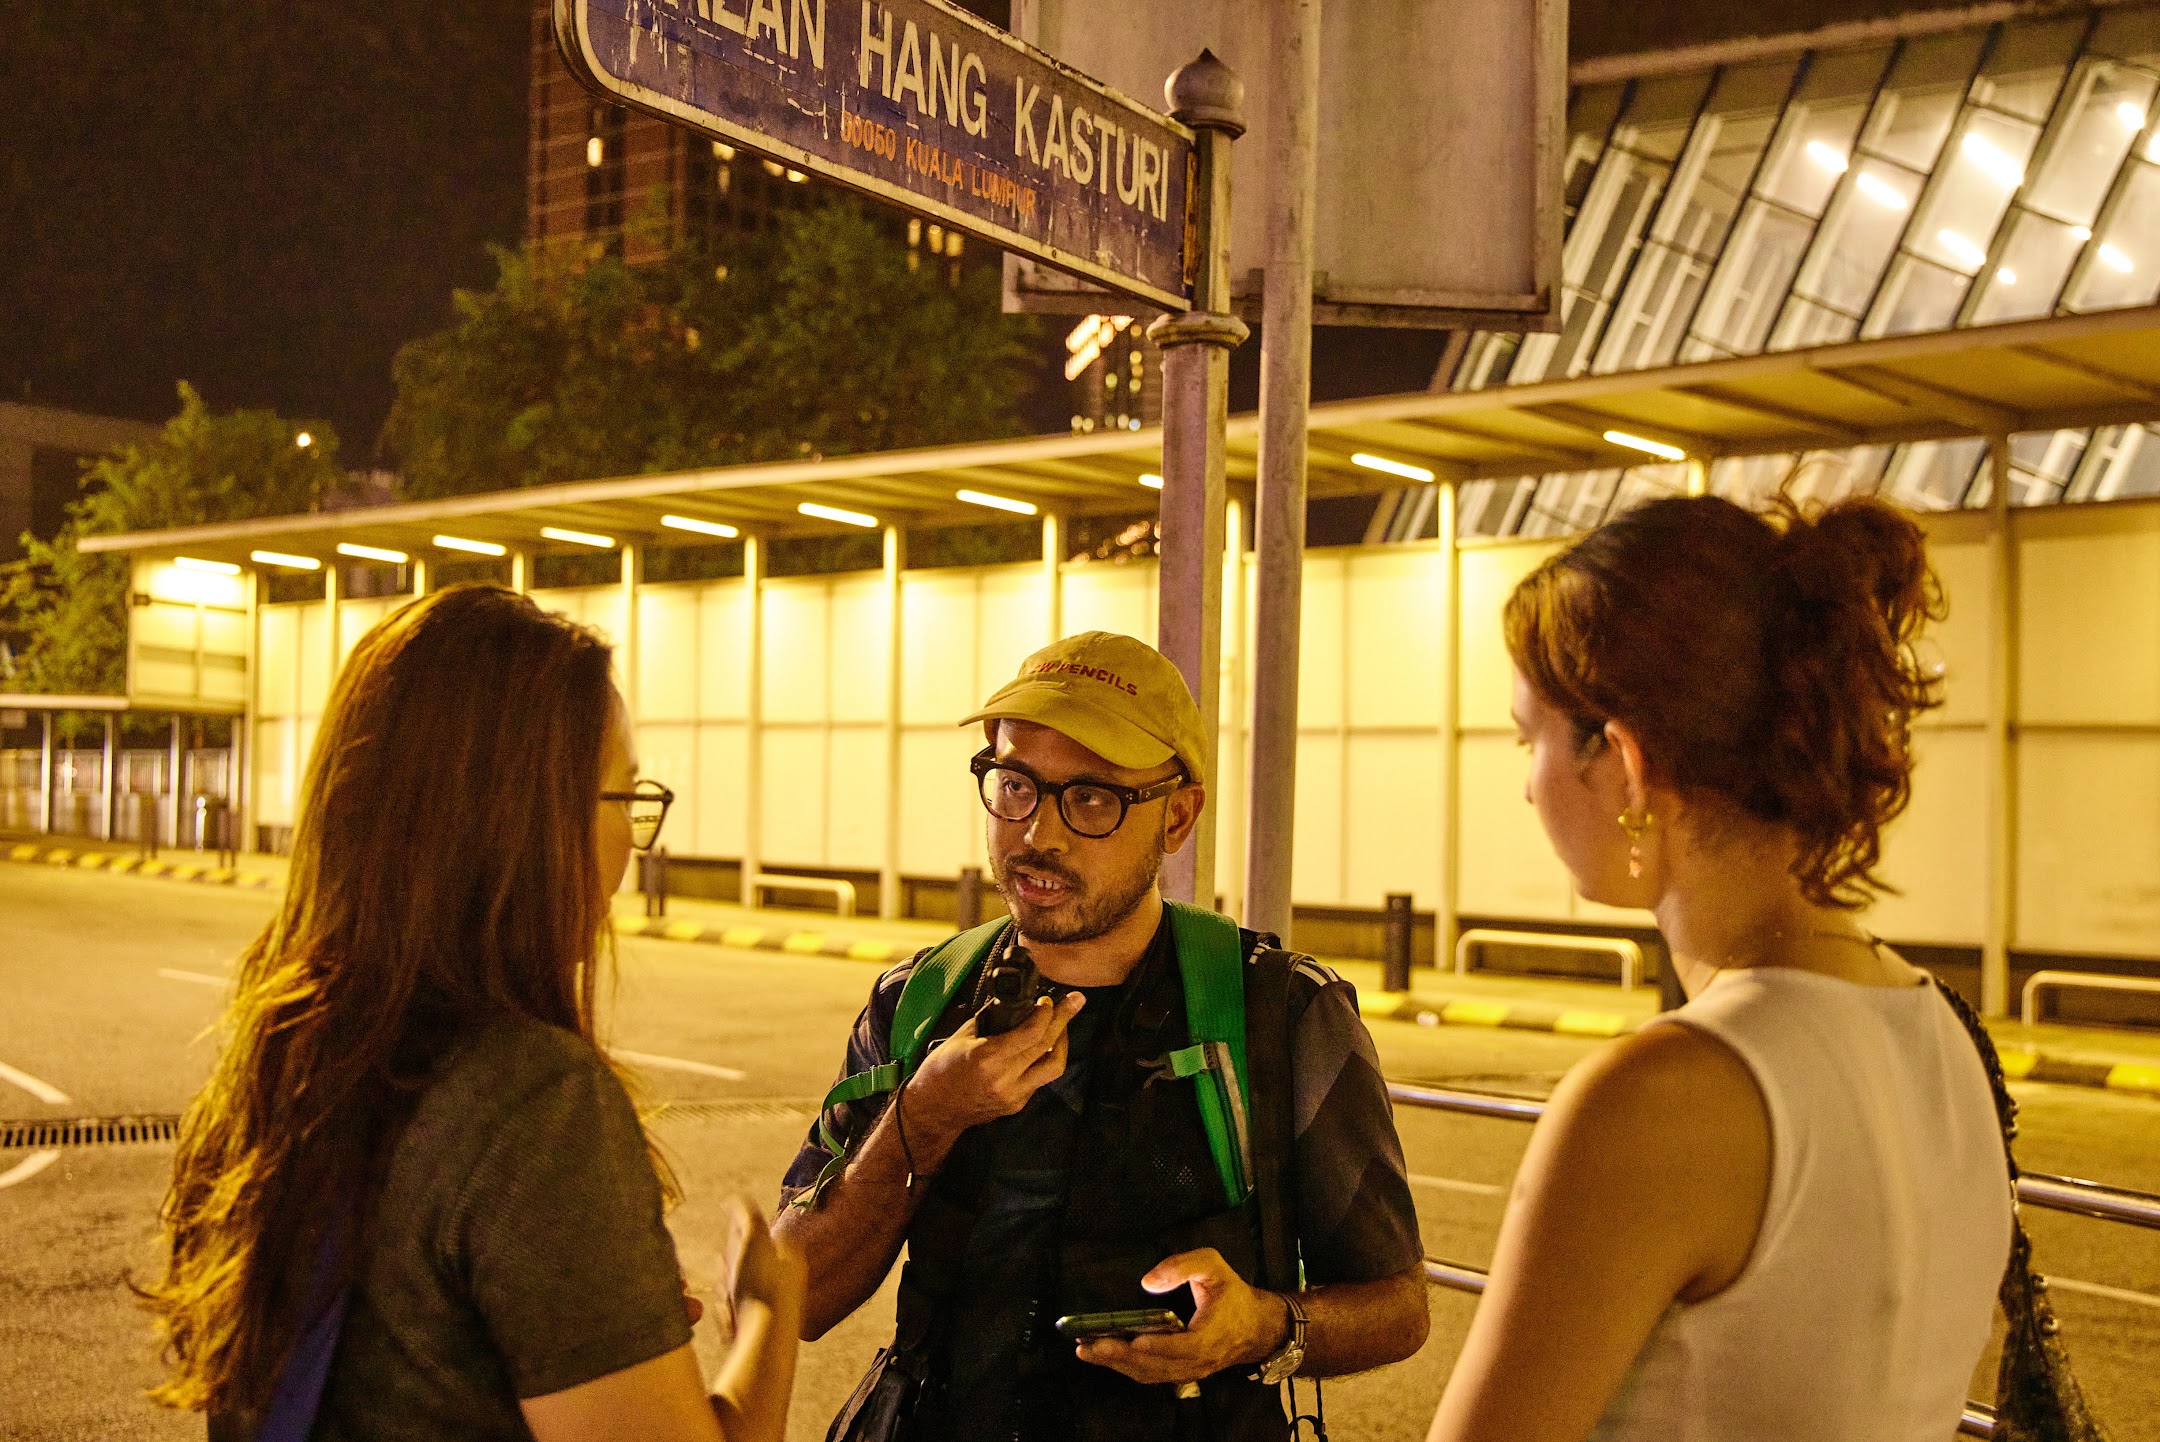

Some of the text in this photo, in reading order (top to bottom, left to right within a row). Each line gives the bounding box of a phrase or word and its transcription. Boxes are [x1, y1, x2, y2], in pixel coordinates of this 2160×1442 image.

[860, 0, 987, 139] HANG
[1014, 75, 1169, 222] KASTURI
[906, 136, 963, 190] KUALA
[971, 165, 1036, 219] LUMPUR
[1056, 662, 1138, 696] PENCILS
